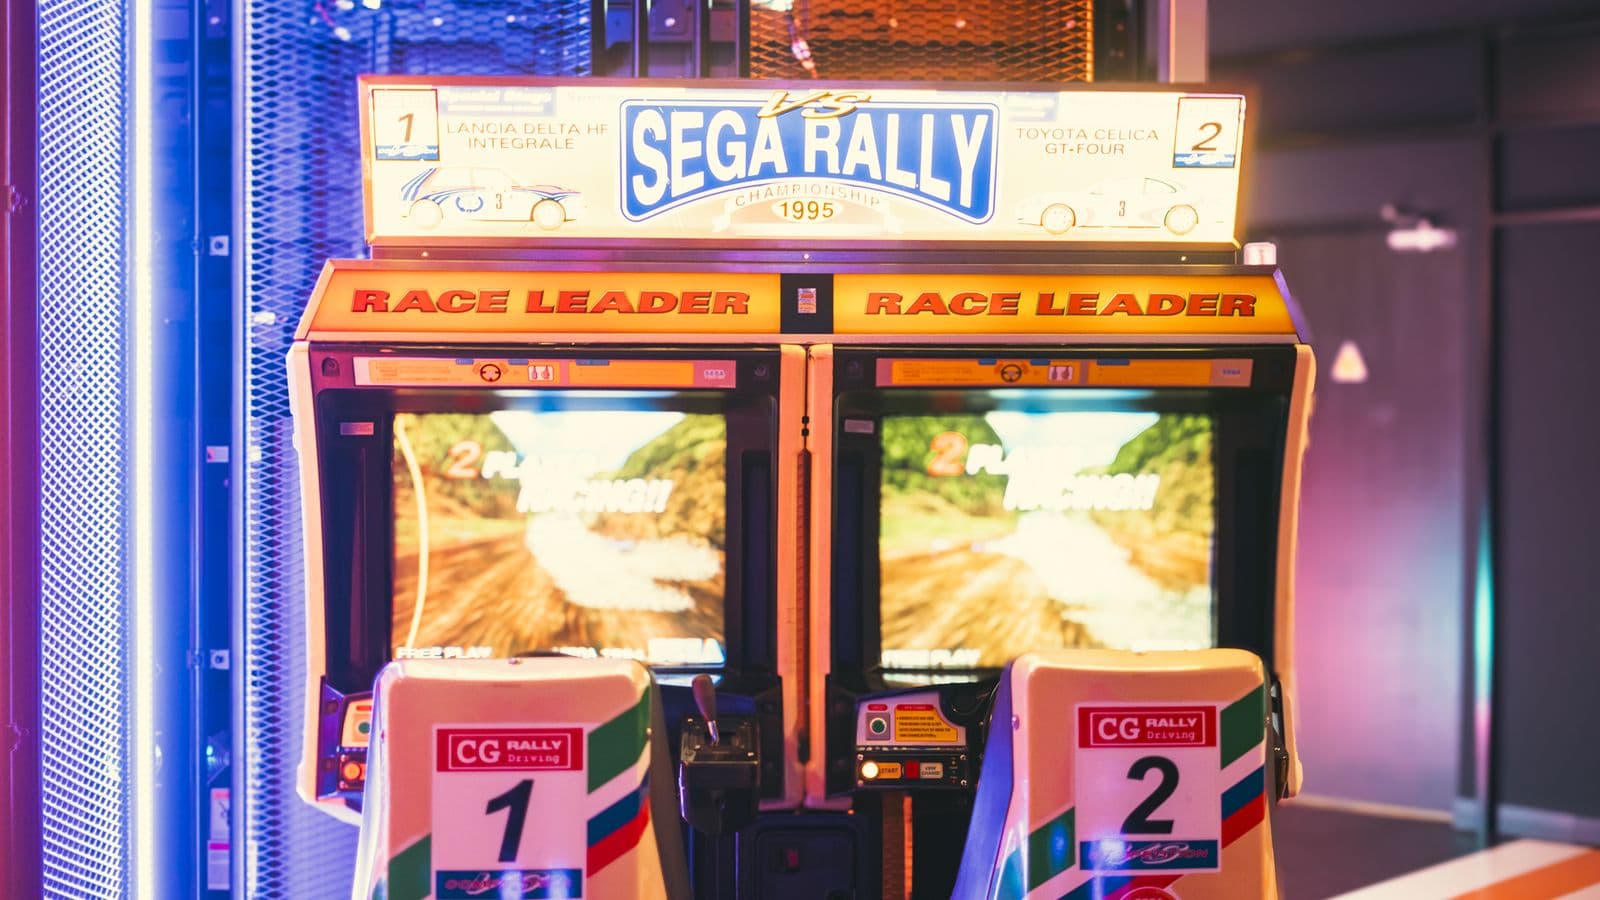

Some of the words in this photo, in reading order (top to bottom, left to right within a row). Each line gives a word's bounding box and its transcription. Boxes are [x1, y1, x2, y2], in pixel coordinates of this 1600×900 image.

[757, 90, 871, 119] VS
[398, 112, 414, 143] 1
[447, 121, 518, 135] LANCIA
[524, 123, 581, 135] DELTA
[586, 123, 610, 136] HF
[1016, 128, 1088, 141] TOYOTA
[1094, 128, 1159, 141] CELICA
[1191, 121, 1223, 151] 2
[467, 137, 575, 150] INTEGRALE
[1045, 143, 1125, 155] GT-FOUR
[631, 108, 788, 206] SEGA
[803, 112, 989, 208] RALLY
[735, 183, 881, 208] CHAMPIONSHIP
[779, 199, 835, 221] 1995
[1118, 200, 1126, 217] 3
[351, 288, 509, 314] RACE
[525, 288, 750, 315] LEADER
[865, 291, 1021, 316] RACE
[1036, 291, 1257, 317] LEADER
[445, 440, 483, 479] 2
[927, 431, 968, 476] 2
[1098, 717, 1141, 740] CG
[1145, 717, 1198, 728] RALLY
[1146, 730, 1196, 741] Driving
[456, 739, 501, 764] CG
[506, 740, 562, 751] RALLY
[508, 753, 560, 765] Driving
[1119, 755, 1180, 835] 2
[485, 778, 534, 863] 1
